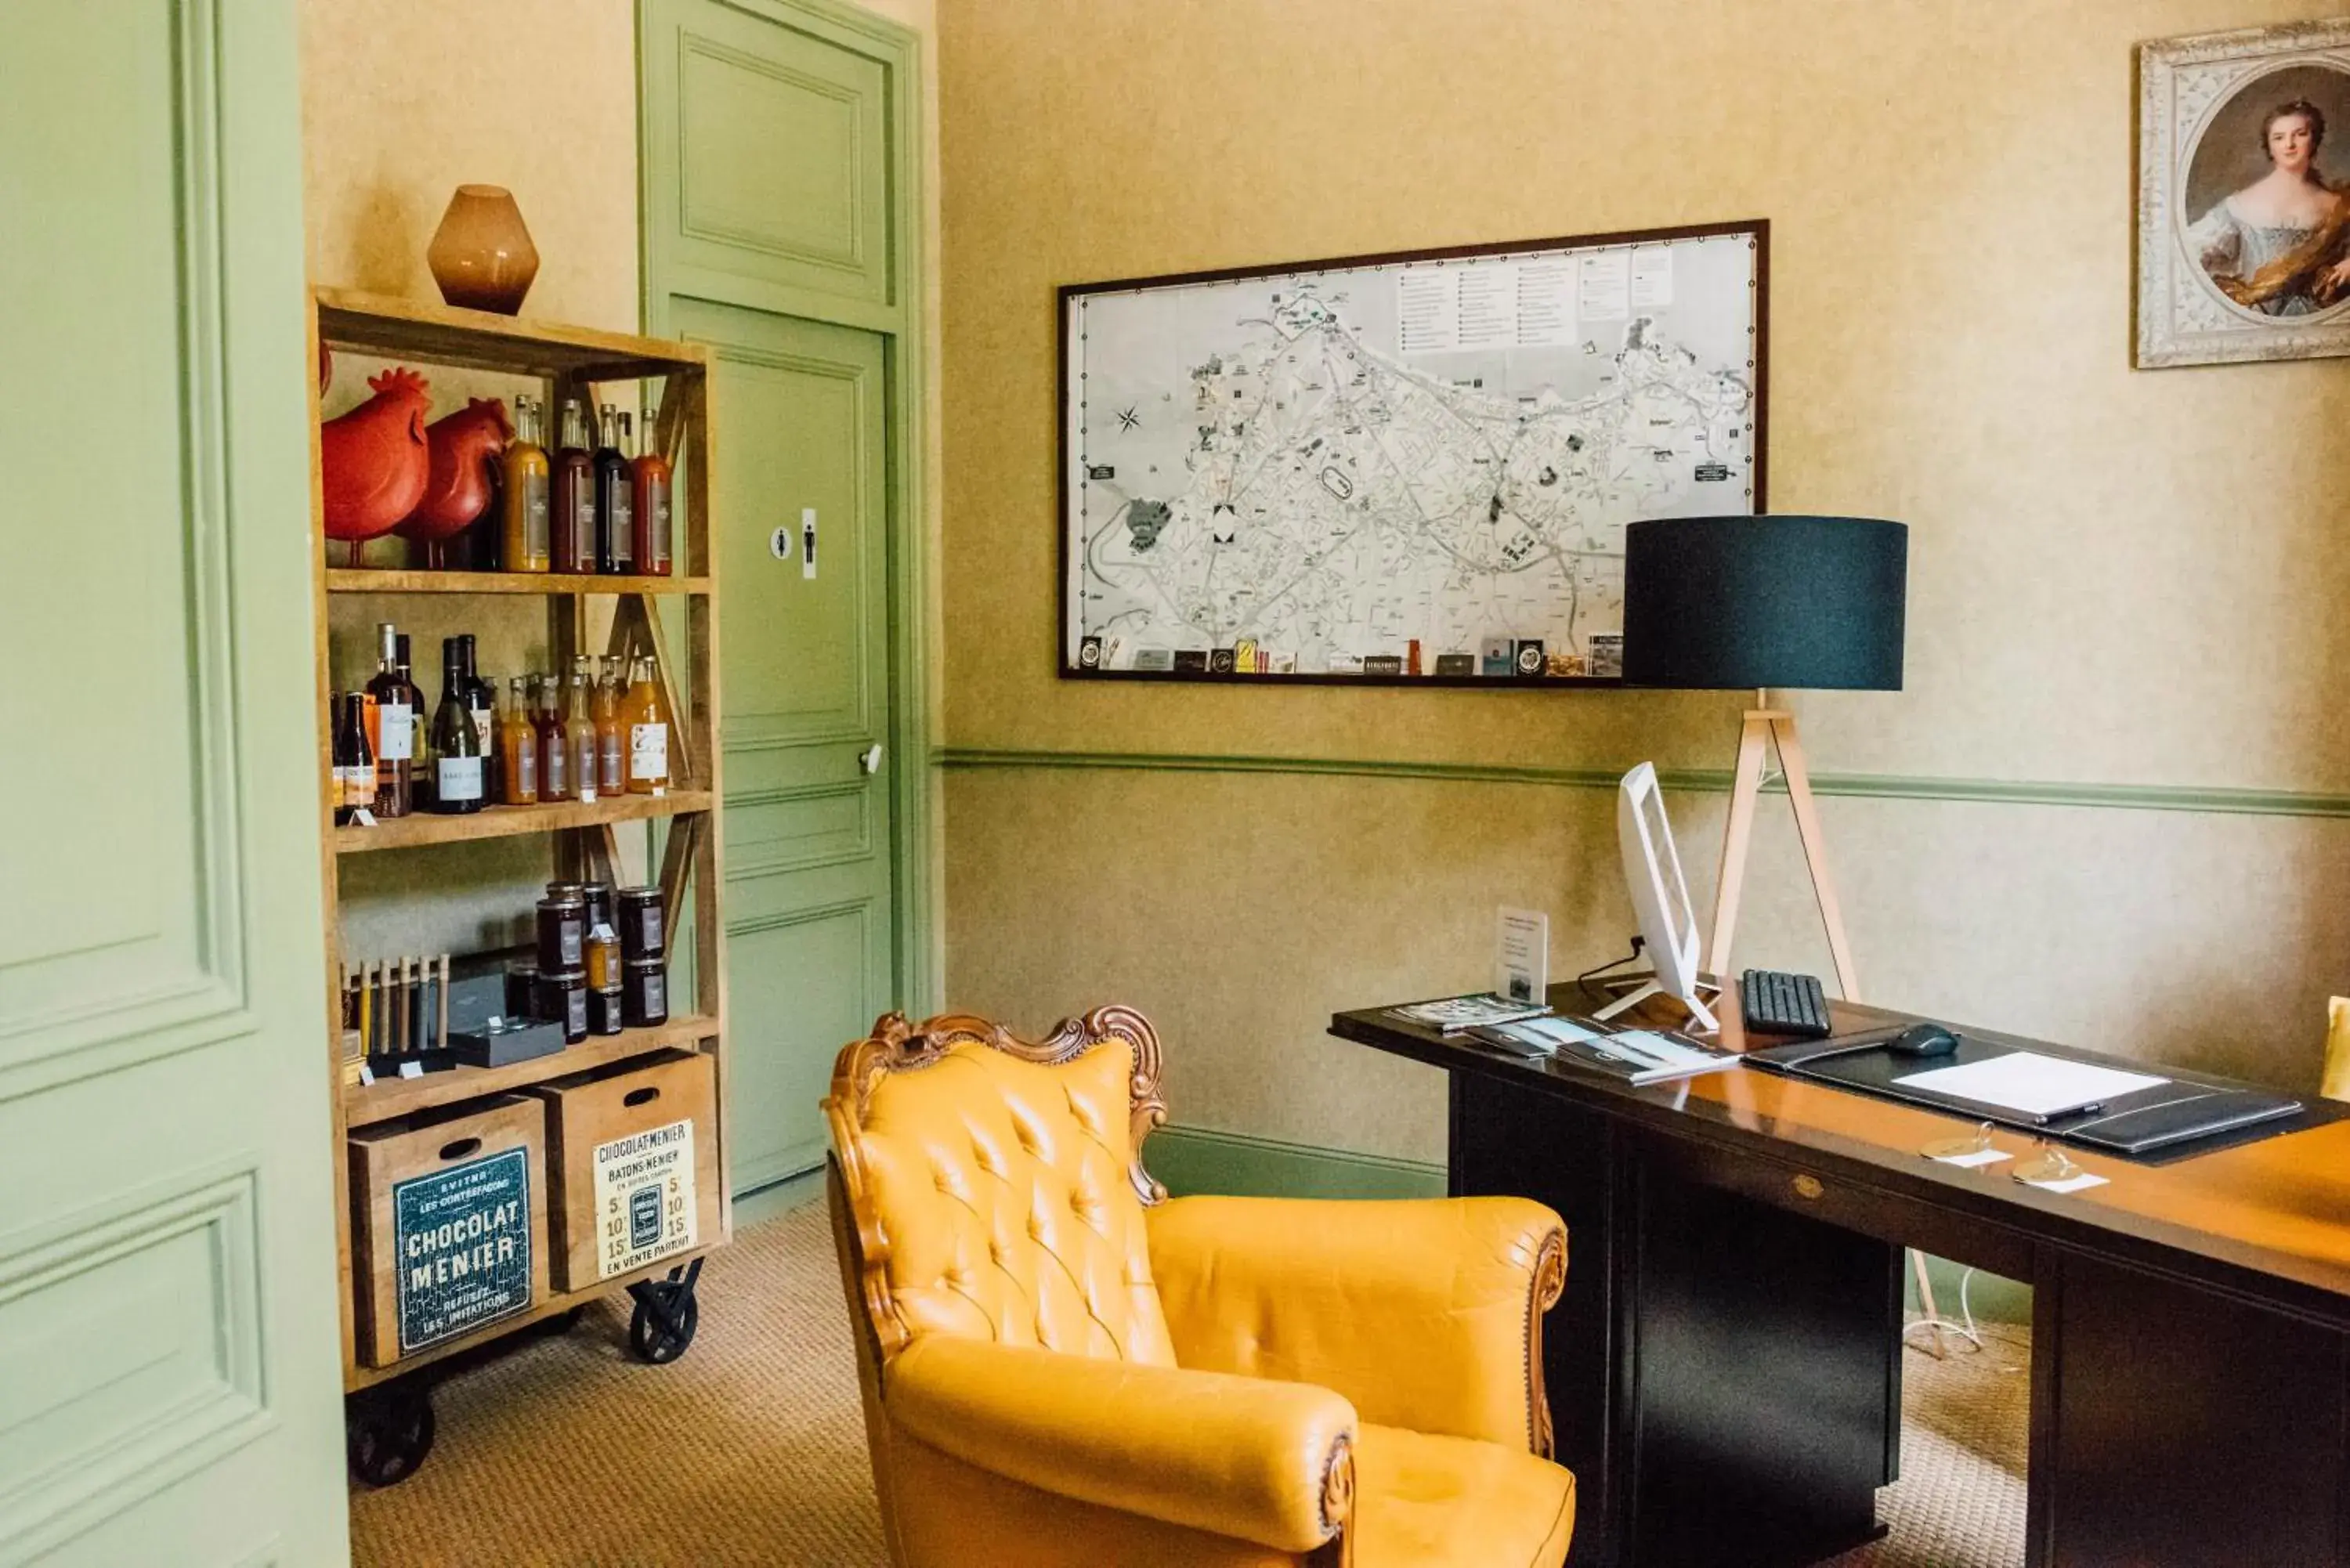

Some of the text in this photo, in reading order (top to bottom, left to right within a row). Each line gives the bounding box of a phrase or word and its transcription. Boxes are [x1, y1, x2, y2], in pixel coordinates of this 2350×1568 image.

[408, 1200, 519, 1257] CHOCOLAT
[411, 1237, 514, 1292] MENIER
[607, 1262, 620, 1274] EN
[623, 1248, 653, 1267] VENTE
